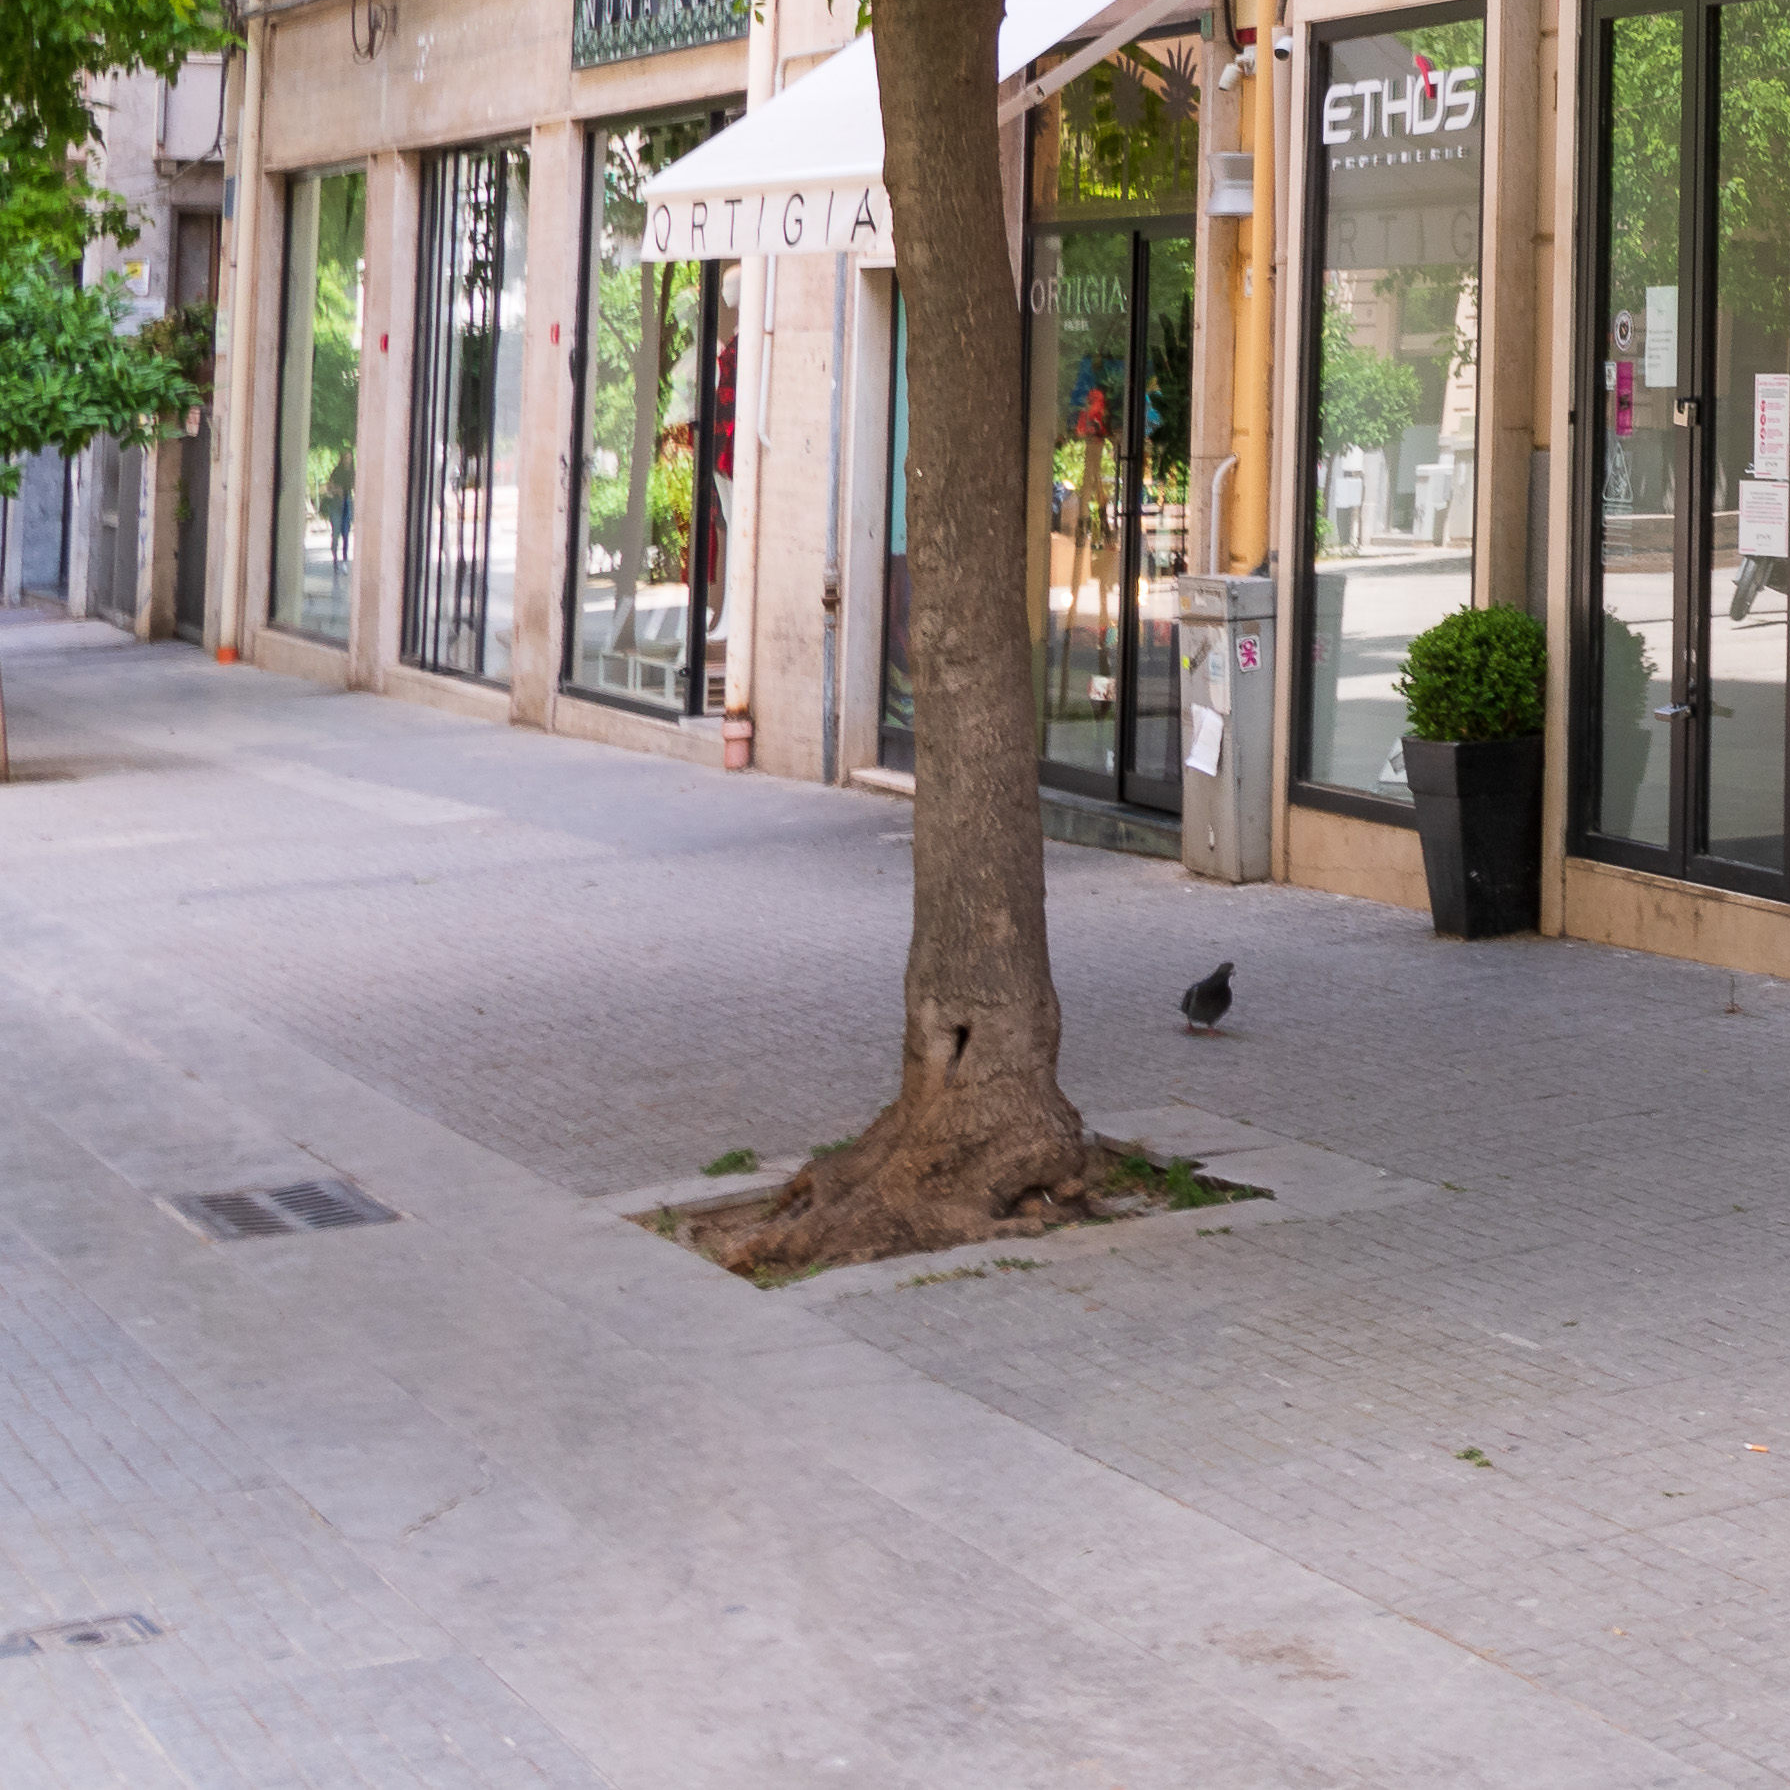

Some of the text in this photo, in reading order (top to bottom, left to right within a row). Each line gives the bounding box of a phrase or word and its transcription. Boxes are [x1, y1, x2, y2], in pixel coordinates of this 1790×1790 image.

[1323, 55, 1480, 145] ETHOS
[653, 187, 877, 253] ORTIGIA
[1030, 275, 1127, 314] ORTIGIA
